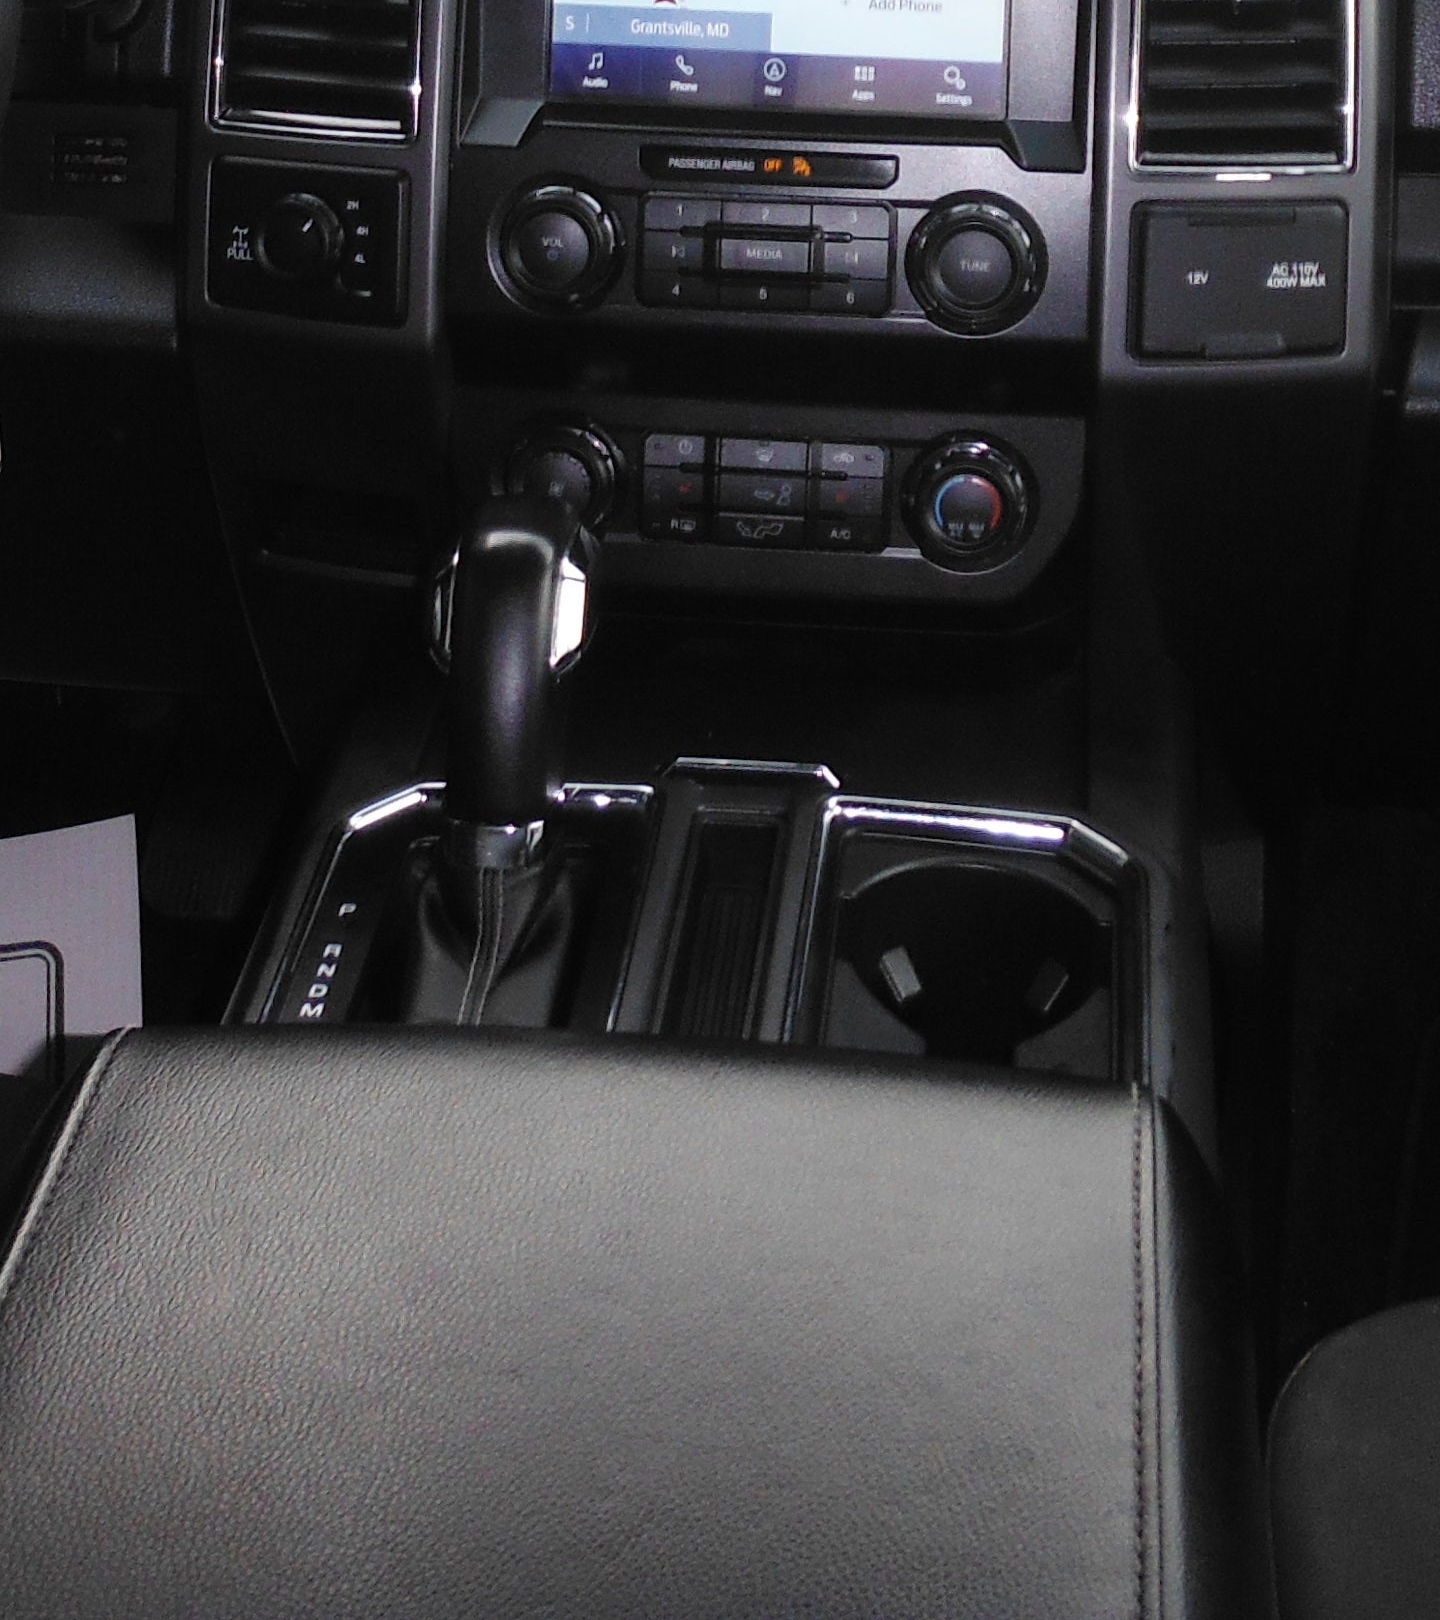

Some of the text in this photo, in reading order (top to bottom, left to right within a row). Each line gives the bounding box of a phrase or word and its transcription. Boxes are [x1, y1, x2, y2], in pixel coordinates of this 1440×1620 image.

[565, 15, 575, 31] S
[630, 18, 730, 39] Grantsville, MD
[582, 74, 609, 89] Audio
[669, 79, 699, 93] Phone
[764, 84, 783, 97] Nav
[851, 88, 876, 102] Apps
[935, 92, 974, 108] Settings
[667, 155, 785, 174] PASSENGER AIRBAG OFF
[542, 235, 564, 248] VOL
[226, 245, 255, 261] PULL
[746, 247, 784, 261] MEDIA
[1186, 269, 1209, 285] 12V
[1292, 261, 1320, 278] 110V
[1299, 273, 1327, 288] MAX
[671, 283, 681, 297] 4
[759, 286, 769, 300] 5
[845, 291, 855, 305] 6
[338, 902, 358, 917] P
[316, 963, 338, 978] N
[308, 983, 330, 998] D
[299, 1002, 326, 1018] M
